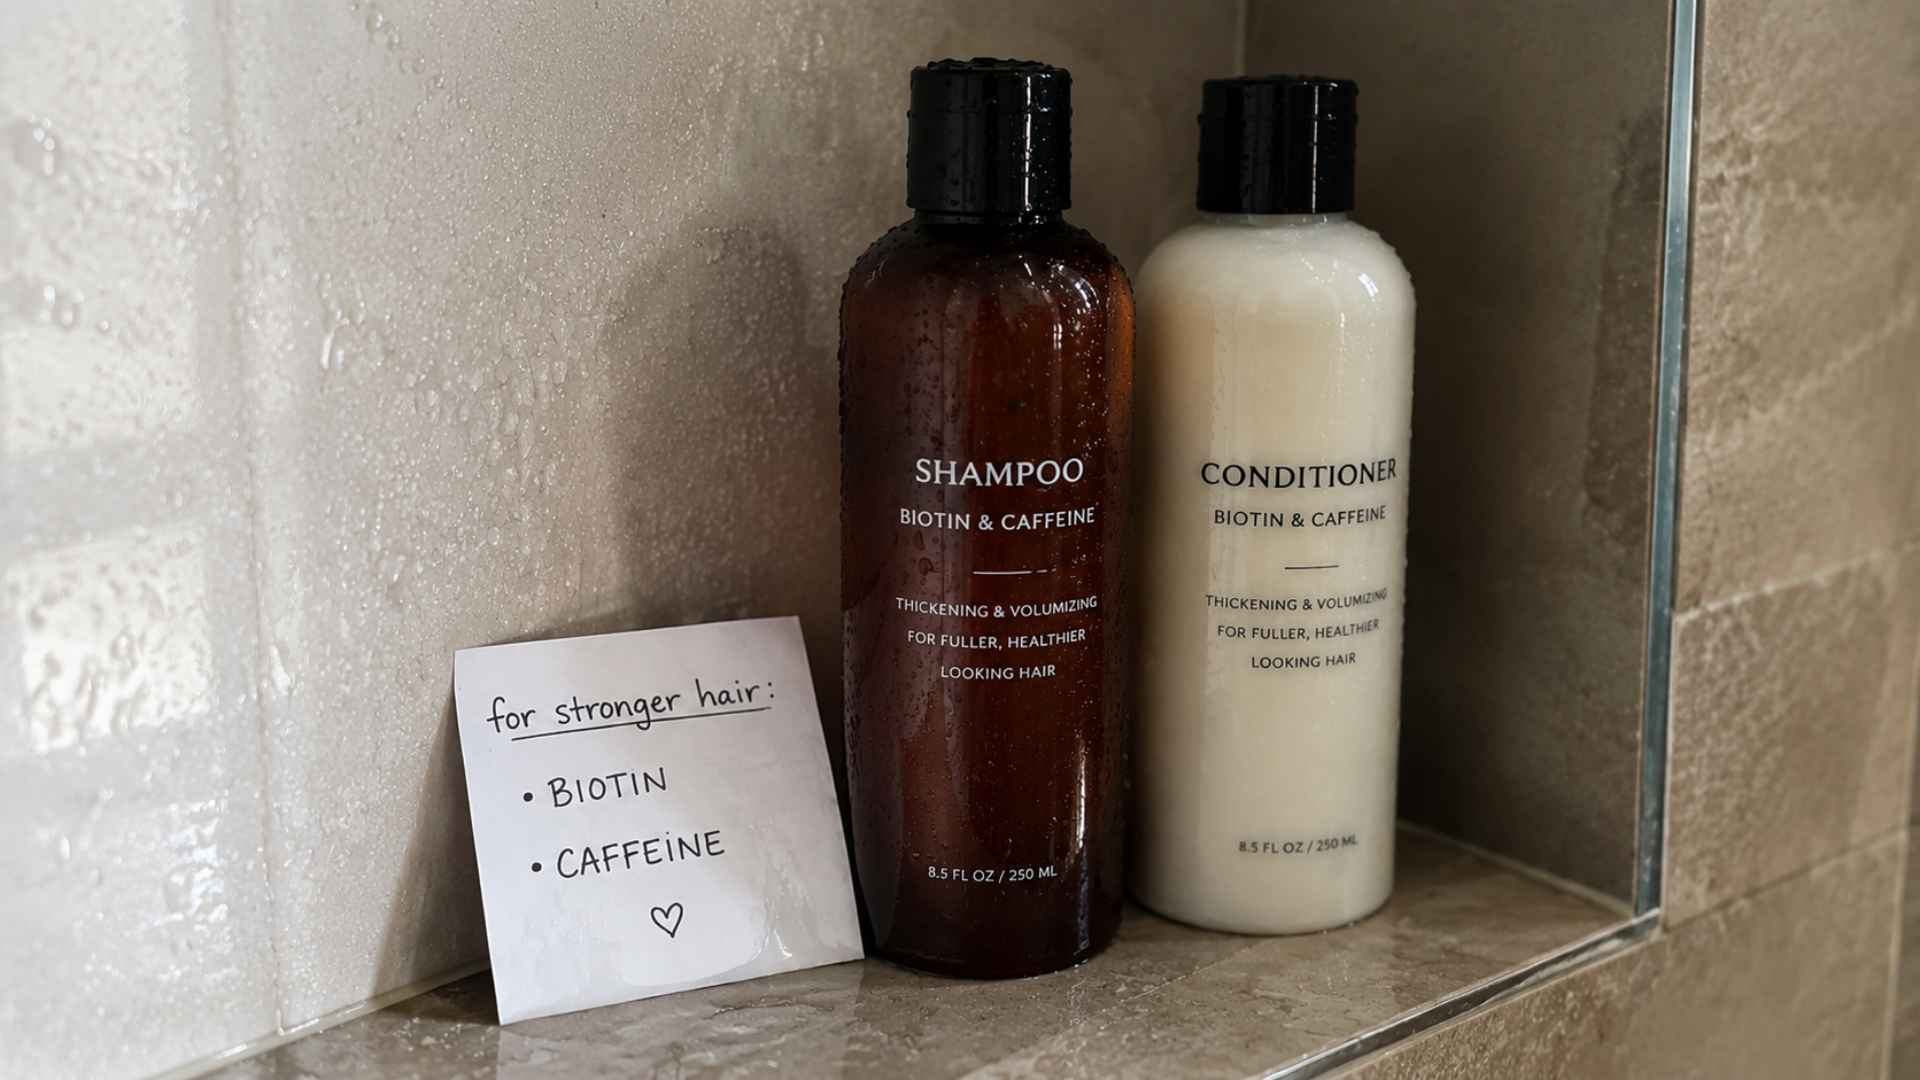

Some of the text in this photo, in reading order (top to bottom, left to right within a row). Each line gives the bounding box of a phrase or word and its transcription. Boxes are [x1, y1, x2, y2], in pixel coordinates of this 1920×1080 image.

[915, 457, 1084, 487] SHAMPOO
[1201, 457, 1397, 488] CONDITIONER
[900, 507, 1095, 530] BIOTIN & CAFFEINE
[1214, 505, 1386, 527] BIOTIN & CAFFEINE
[896, 596, 1097, 618] THICKENING & VOLUMIZING
[1205, 587, 1387, 611] THICKENING & VOLUMIZING
[907, 629, 1086, 650] FOR FULLER, HEALTHIER
[1217, 618, 1379, 641] FOR FULLER, HEALTHIER
[1251, 652, 1356, 669] LOOKING HAIR
[941, 664, 1056, 680] LOOKING HAIR
[486, 678, 775, 733] for stronger hair:
[547, 767, 667, 808] BIOTIN
[1239, 841, 1258, 854] 8.5
[1263, 841, 1279, 854] FL
[1282, 841, 1304, 854] OZ
[1306, 840, 1314, 854] /
[1316, 837, 1339, 852] 250
[928, 865, 1057, 884] 8.5 FL OZ / 250 ML
